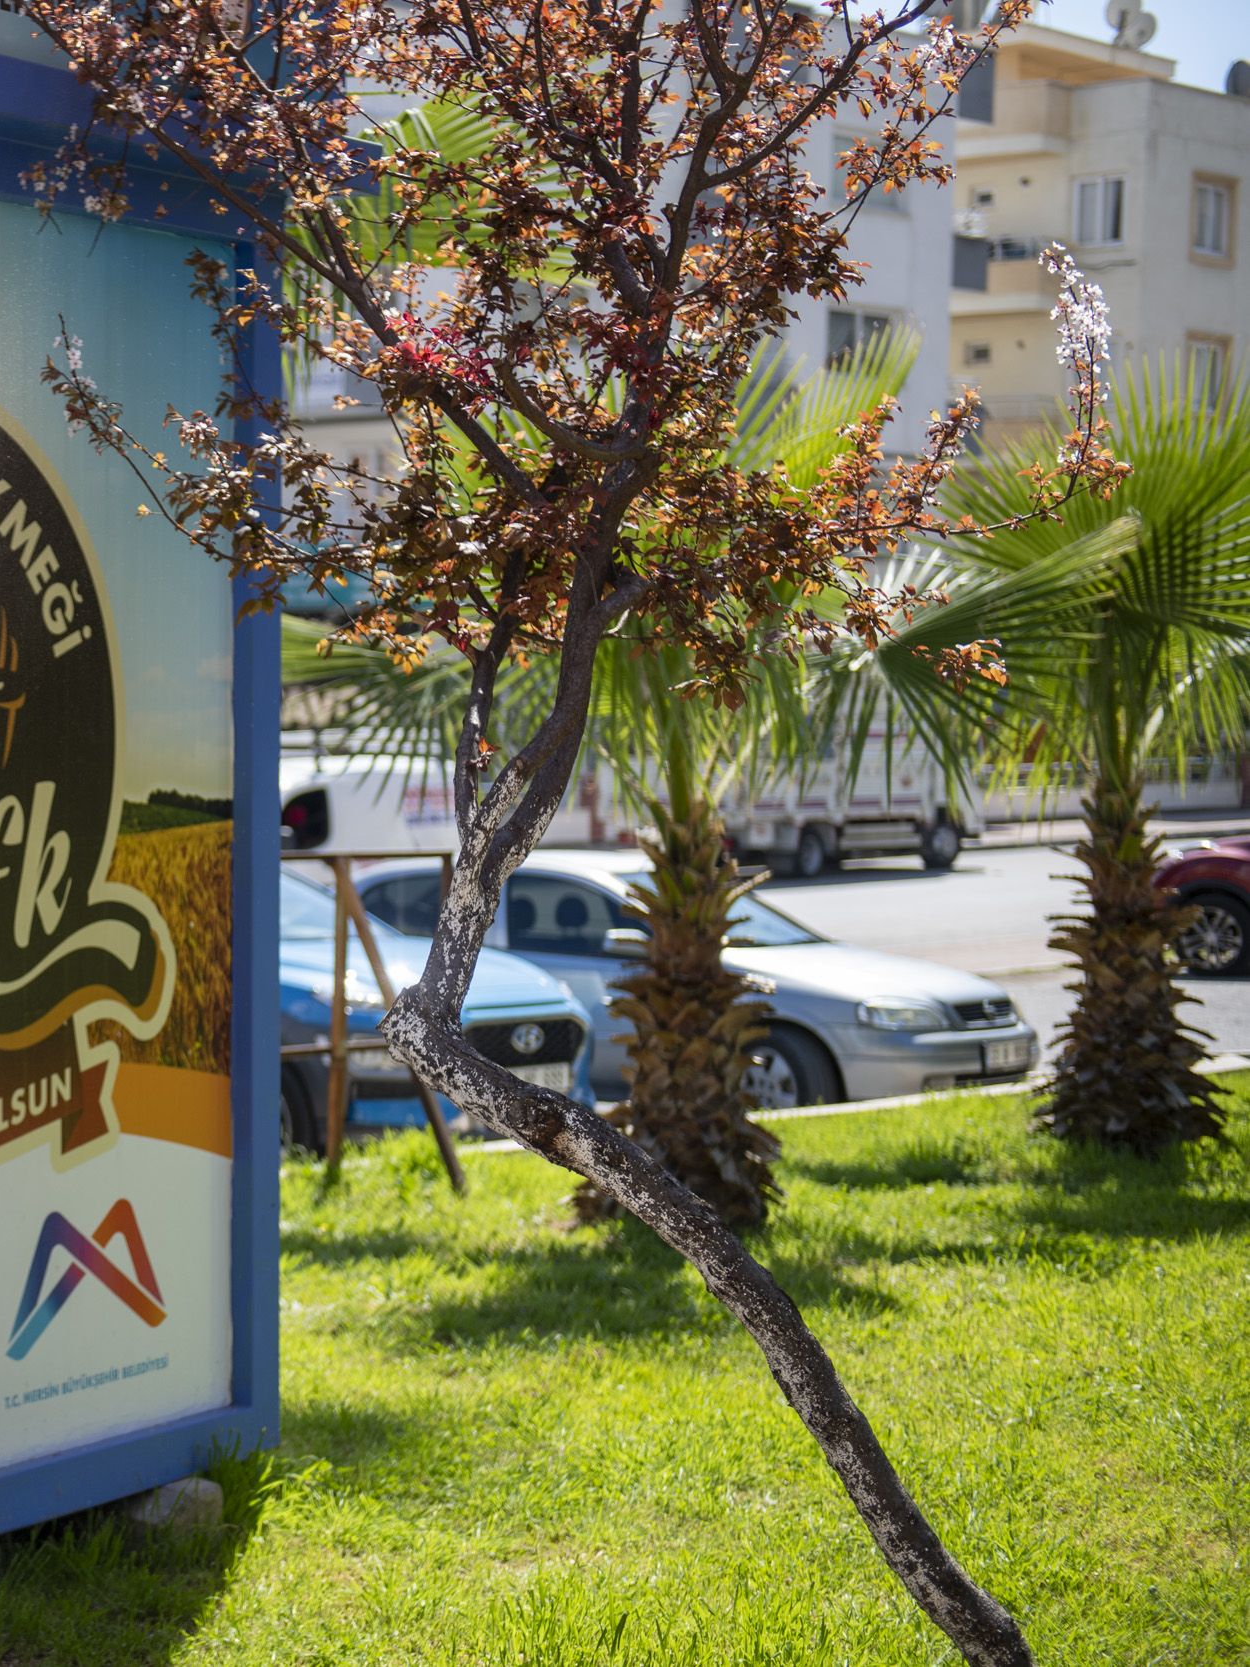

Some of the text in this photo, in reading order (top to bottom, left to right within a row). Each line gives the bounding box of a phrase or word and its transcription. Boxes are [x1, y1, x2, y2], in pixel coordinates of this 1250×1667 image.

[4, 1352, 170, 1409] T.C. MERSİN BÜYÜKŞEHİR BELEDİYESİ
